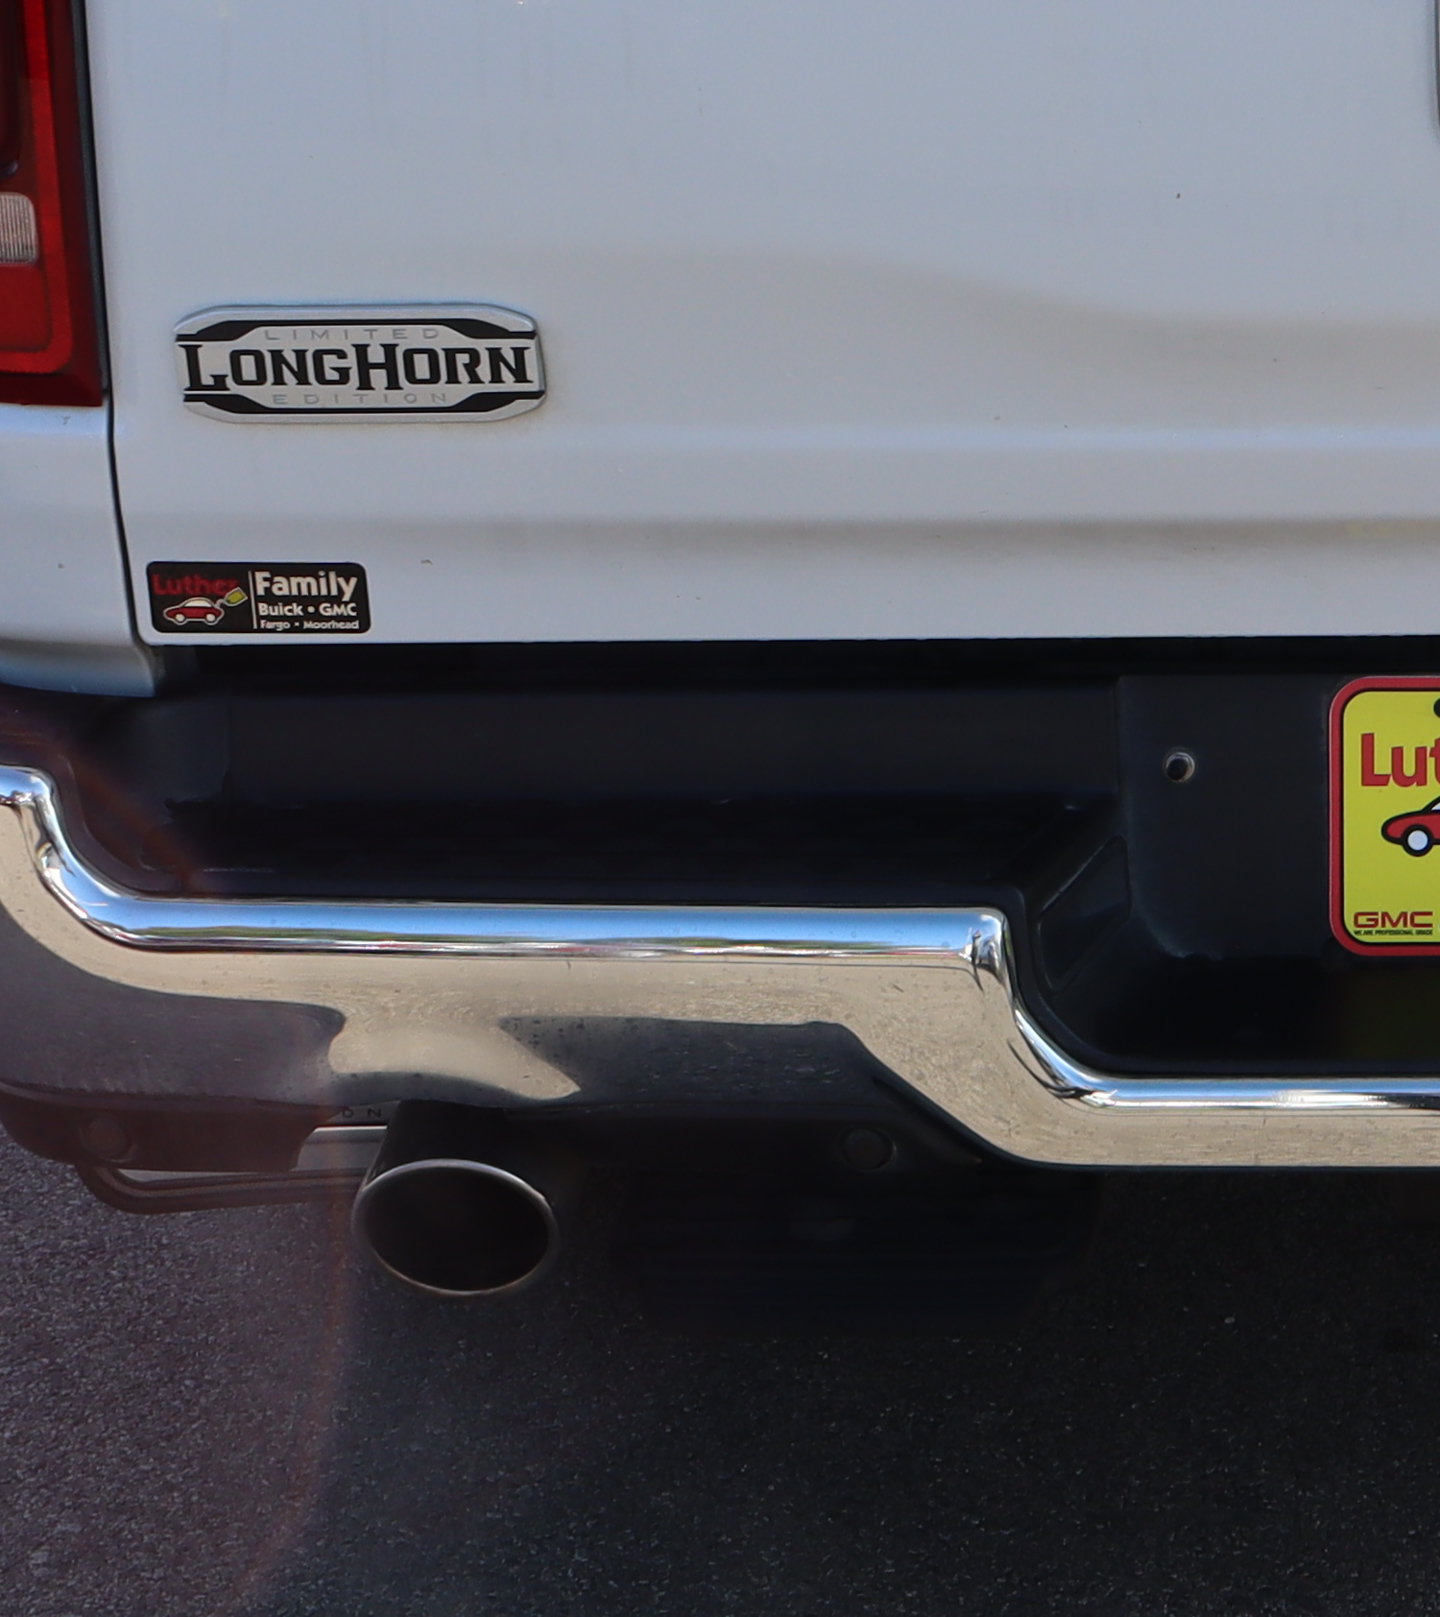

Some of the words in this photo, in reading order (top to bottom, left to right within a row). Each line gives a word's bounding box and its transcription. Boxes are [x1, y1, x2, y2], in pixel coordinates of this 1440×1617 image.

[264, 328, 440, 341] LIMITED
[271, 392, 448, 405] EDITION
[151, 572, 240, 596] Luther
[254, 570, 358, 602] Family
[259, 602, 304, 617] Buick
[319, 602, 358, 617] GMC
[260, 619, 292, 632] Fargo
[303, 619, 360, 631] Moorhead
[1353, 911, 1434, 929] GMC
